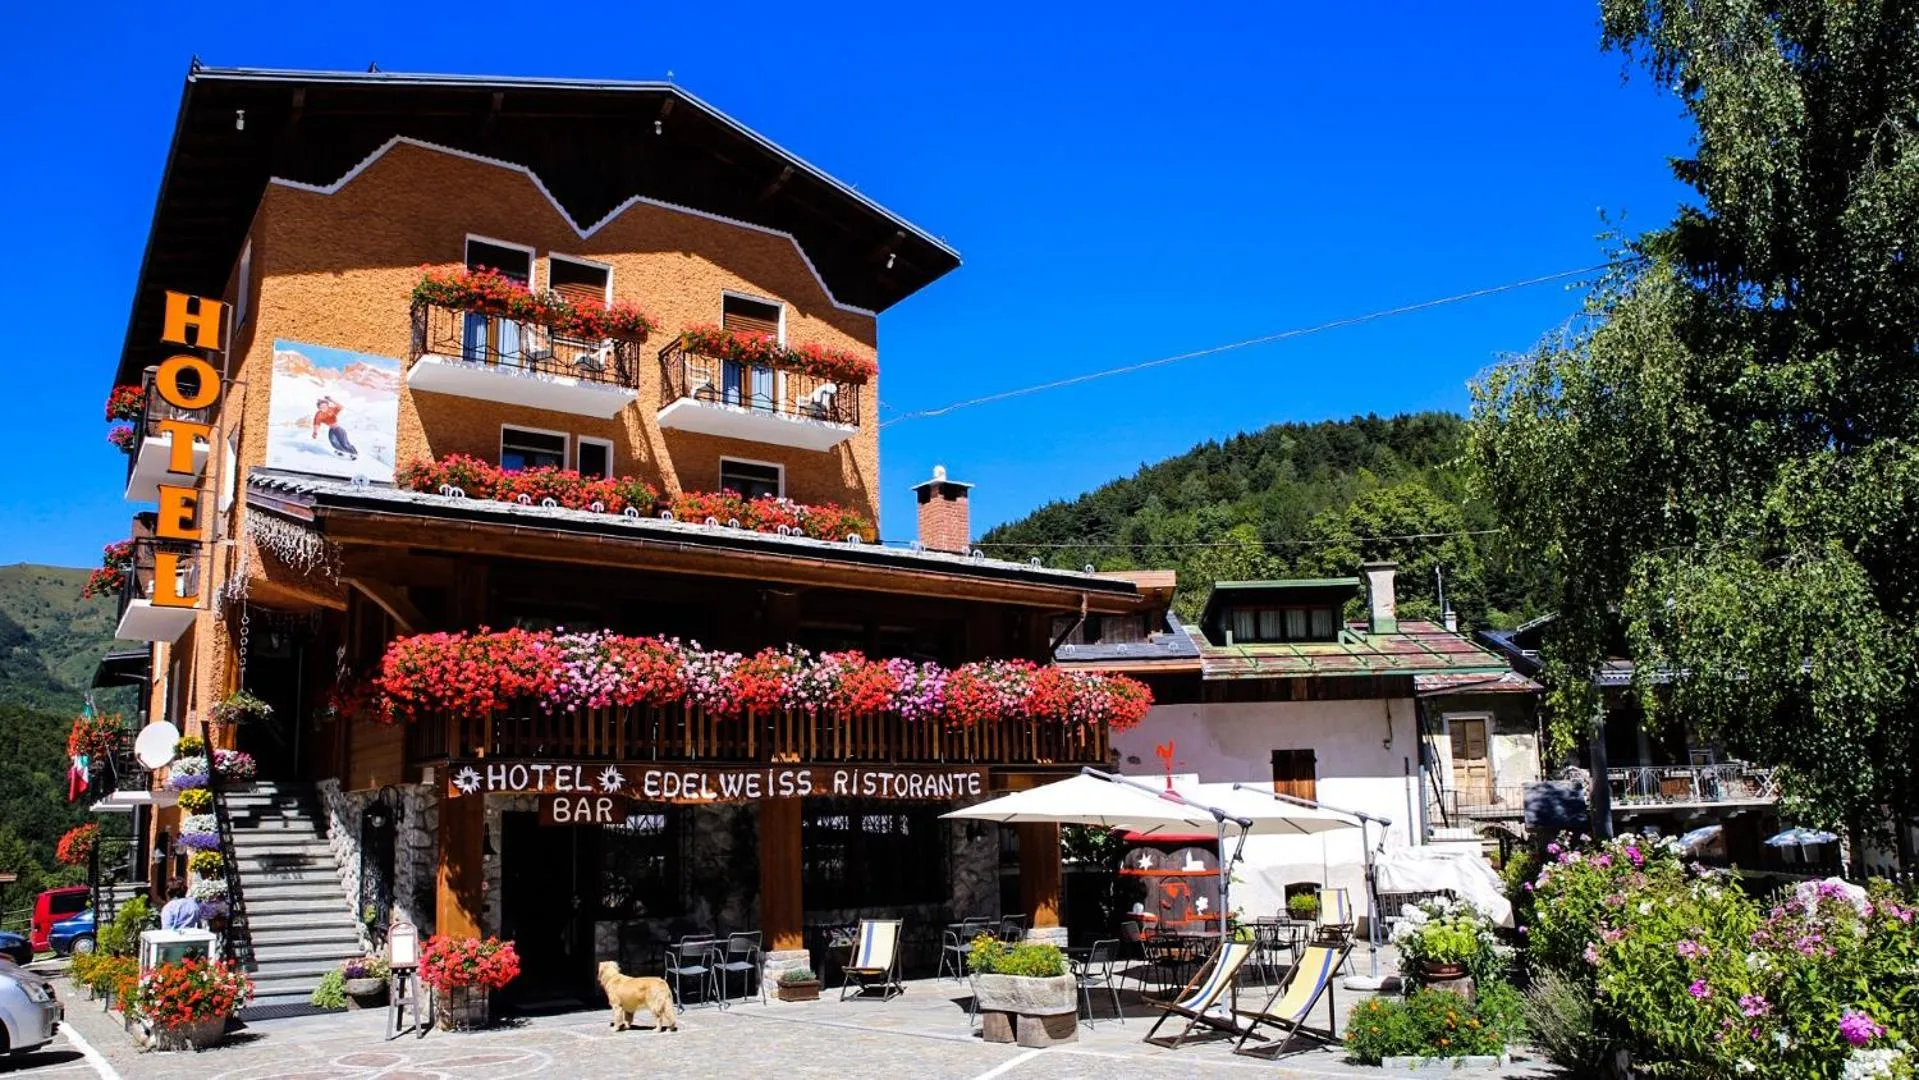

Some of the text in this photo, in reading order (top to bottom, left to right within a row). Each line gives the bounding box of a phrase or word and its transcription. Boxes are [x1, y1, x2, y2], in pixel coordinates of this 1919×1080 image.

[150, 289, 223, 608] HOTEL
[487, 764, 593, 792] HOTEL
[552, 797, 614, 823] BAR
